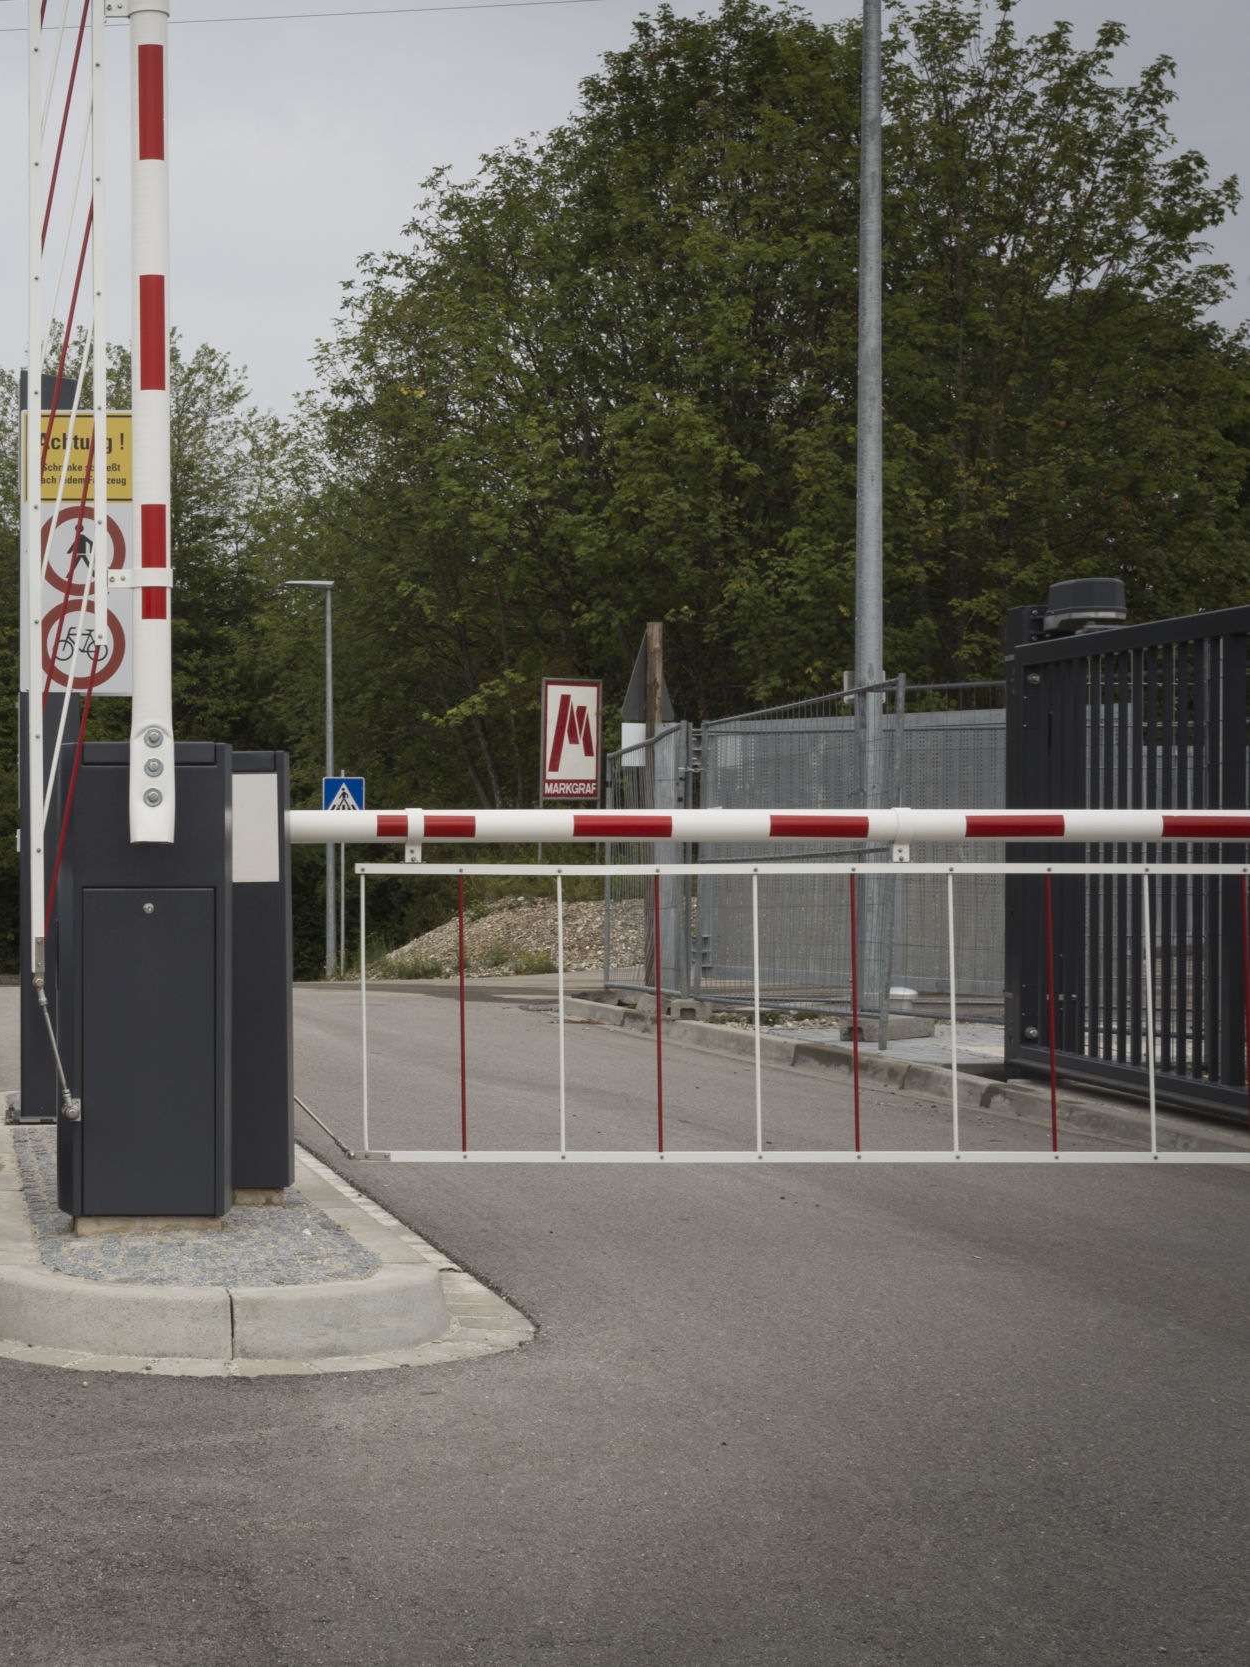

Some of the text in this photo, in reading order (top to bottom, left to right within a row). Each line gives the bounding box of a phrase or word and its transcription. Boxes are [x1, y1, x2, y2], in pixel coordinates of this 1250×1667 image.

[40, 432, 112, 454] Achtug
[43, 463, 83, 472] Schrnke
[40, 475, 57, 485] ach
[544, 782, 597, 794] MARKGRAF
